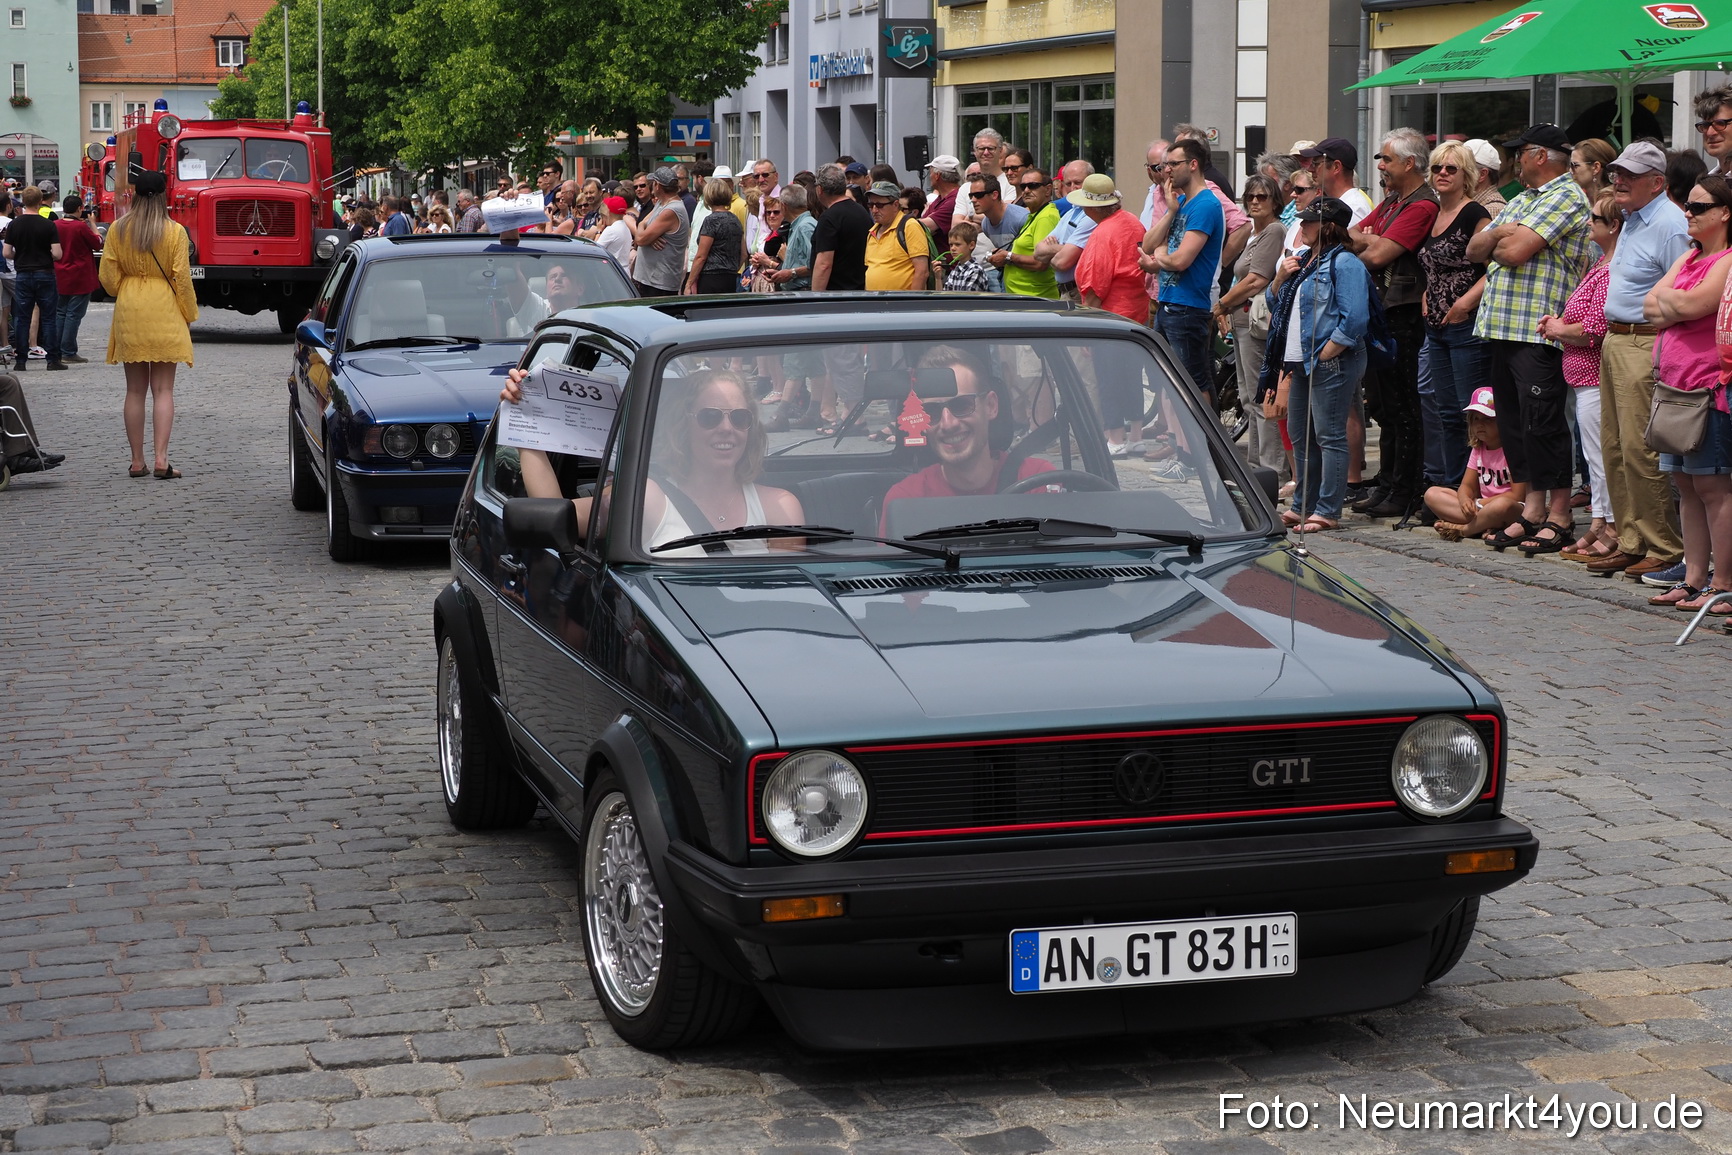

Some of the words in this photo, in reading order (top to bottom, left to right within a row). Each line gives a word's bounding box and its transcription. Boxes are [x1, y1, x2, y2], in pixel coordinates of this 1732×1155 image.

[900, 34, 920, 59] G2
[1618, 49, 1663, 61] La
[558, 380, 603, 401] 433
[1252, 757, 1311, 787] GTI
[1043, 936, 1095, 983] AN
[1126, 930, 1177, 977] GT
[1021, 967, 1031, 981] D
